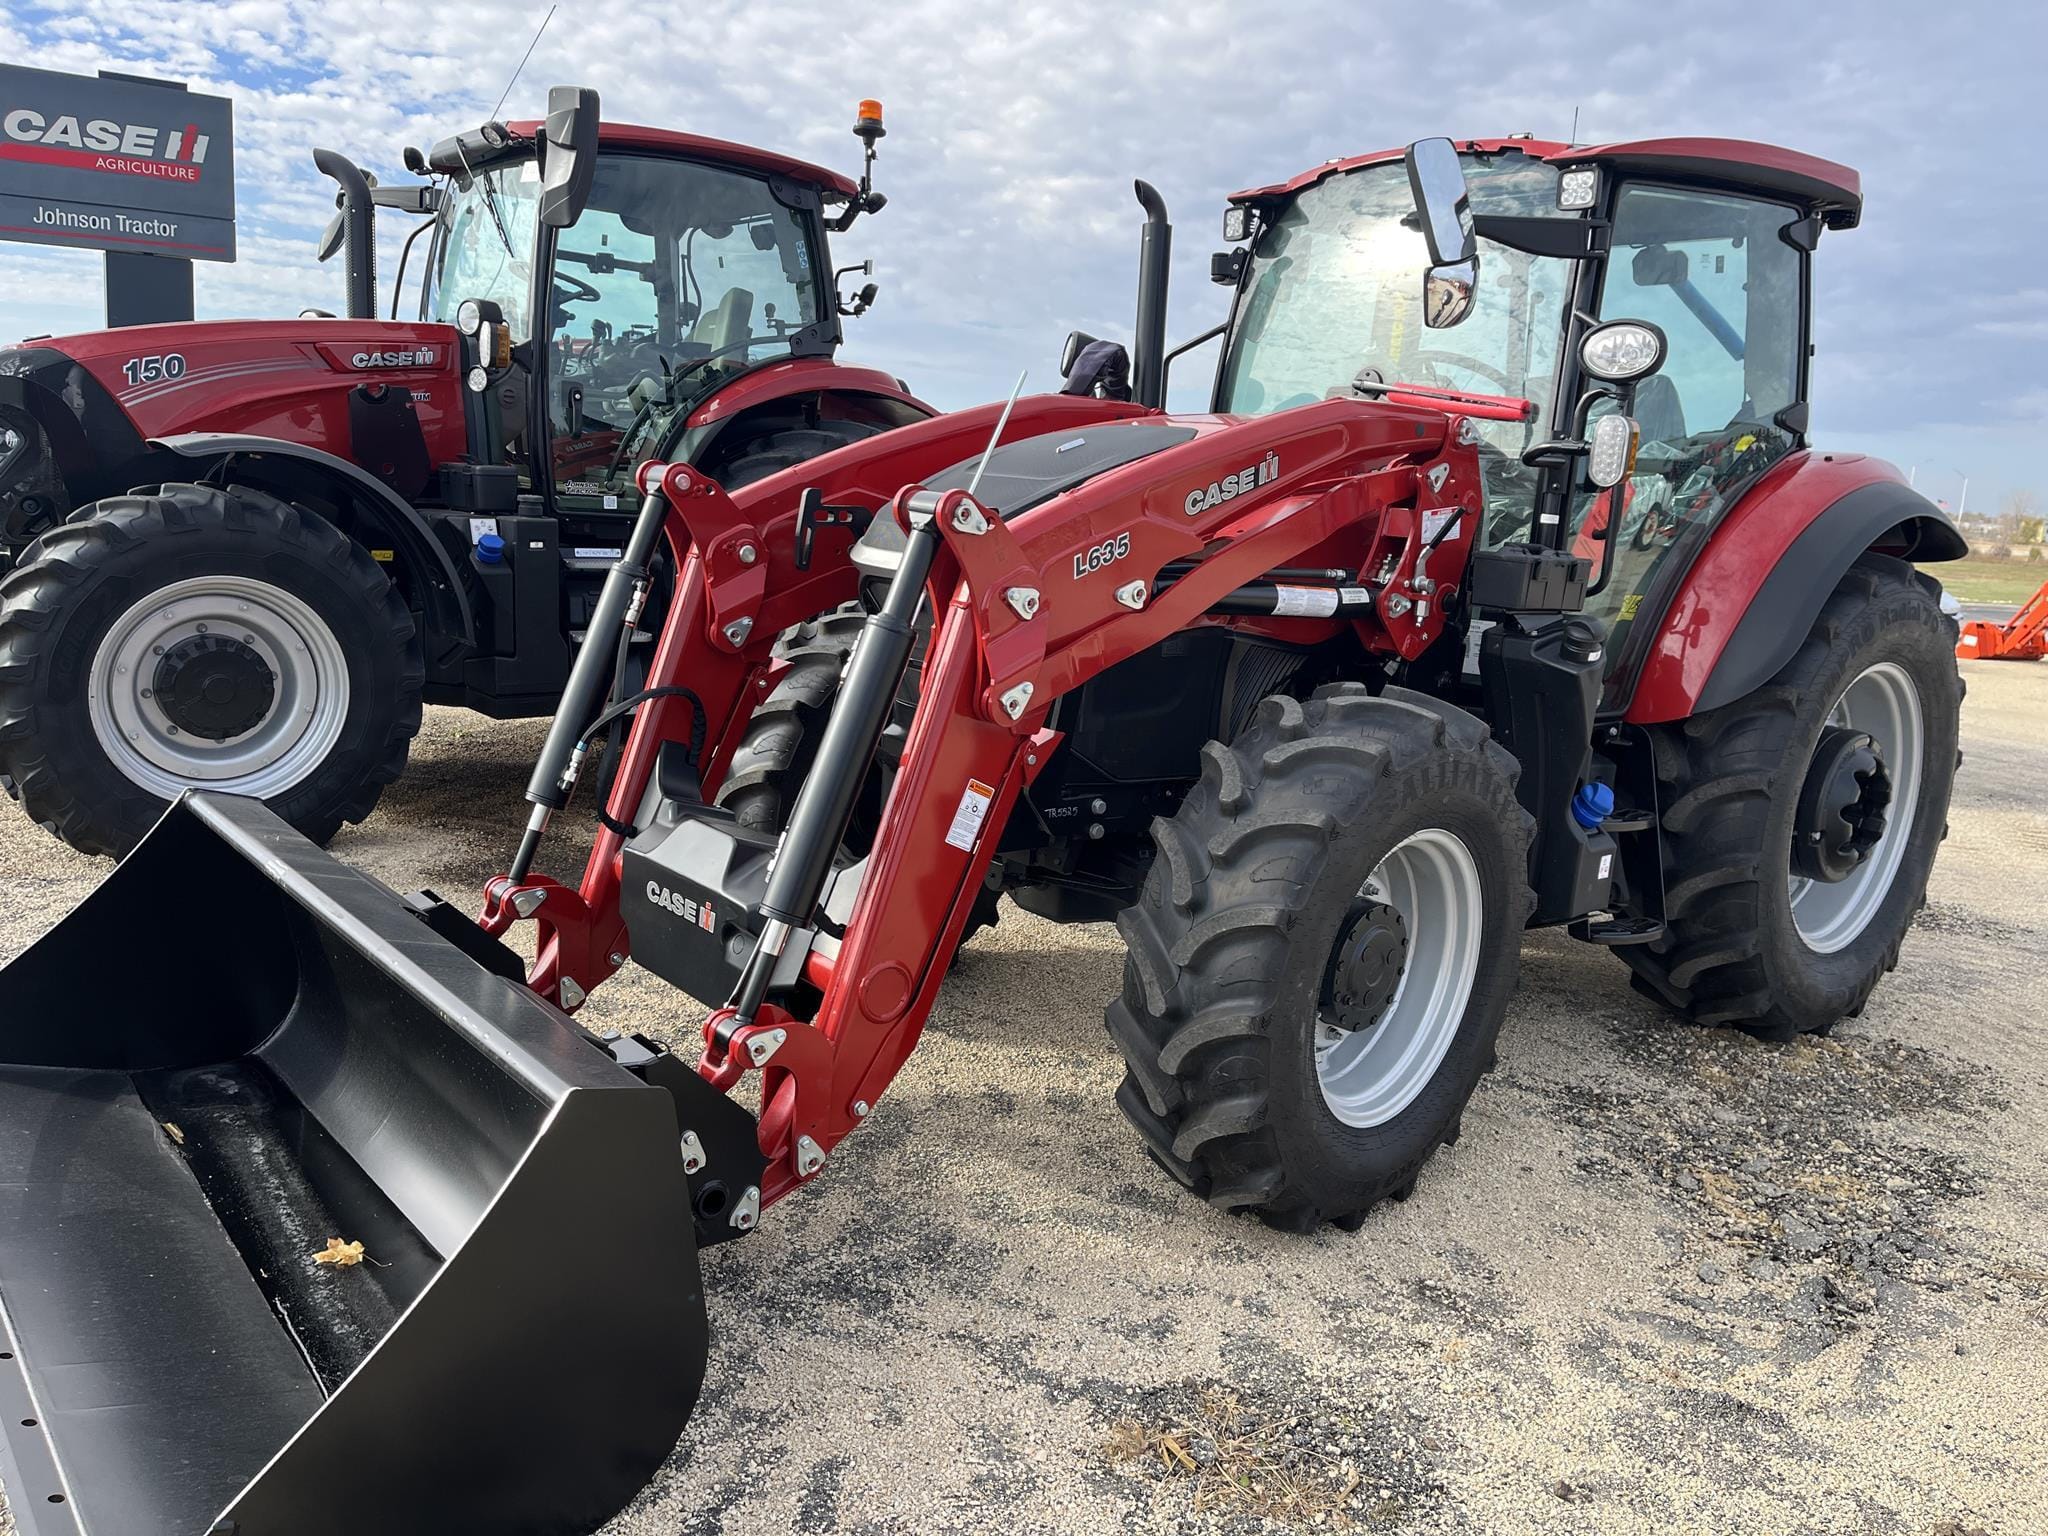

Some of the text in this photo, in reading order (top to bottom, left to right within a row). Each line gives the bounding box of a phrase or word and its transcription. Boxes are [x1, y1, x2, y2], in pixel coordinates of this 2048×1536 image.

[3, 109, 158, 157] CASE
[95, 157, 195, 180] AGRICULTURE
[33, 206, 178, 238] Johnson Tractor
[123, 353, 186, 386] 150
[352, 351, 413, 368] CASE
[1184, 466, 1255, 516] CASE
[1074, 531, 1130, 580] L635
[646, 880, 697, 924] CASE
